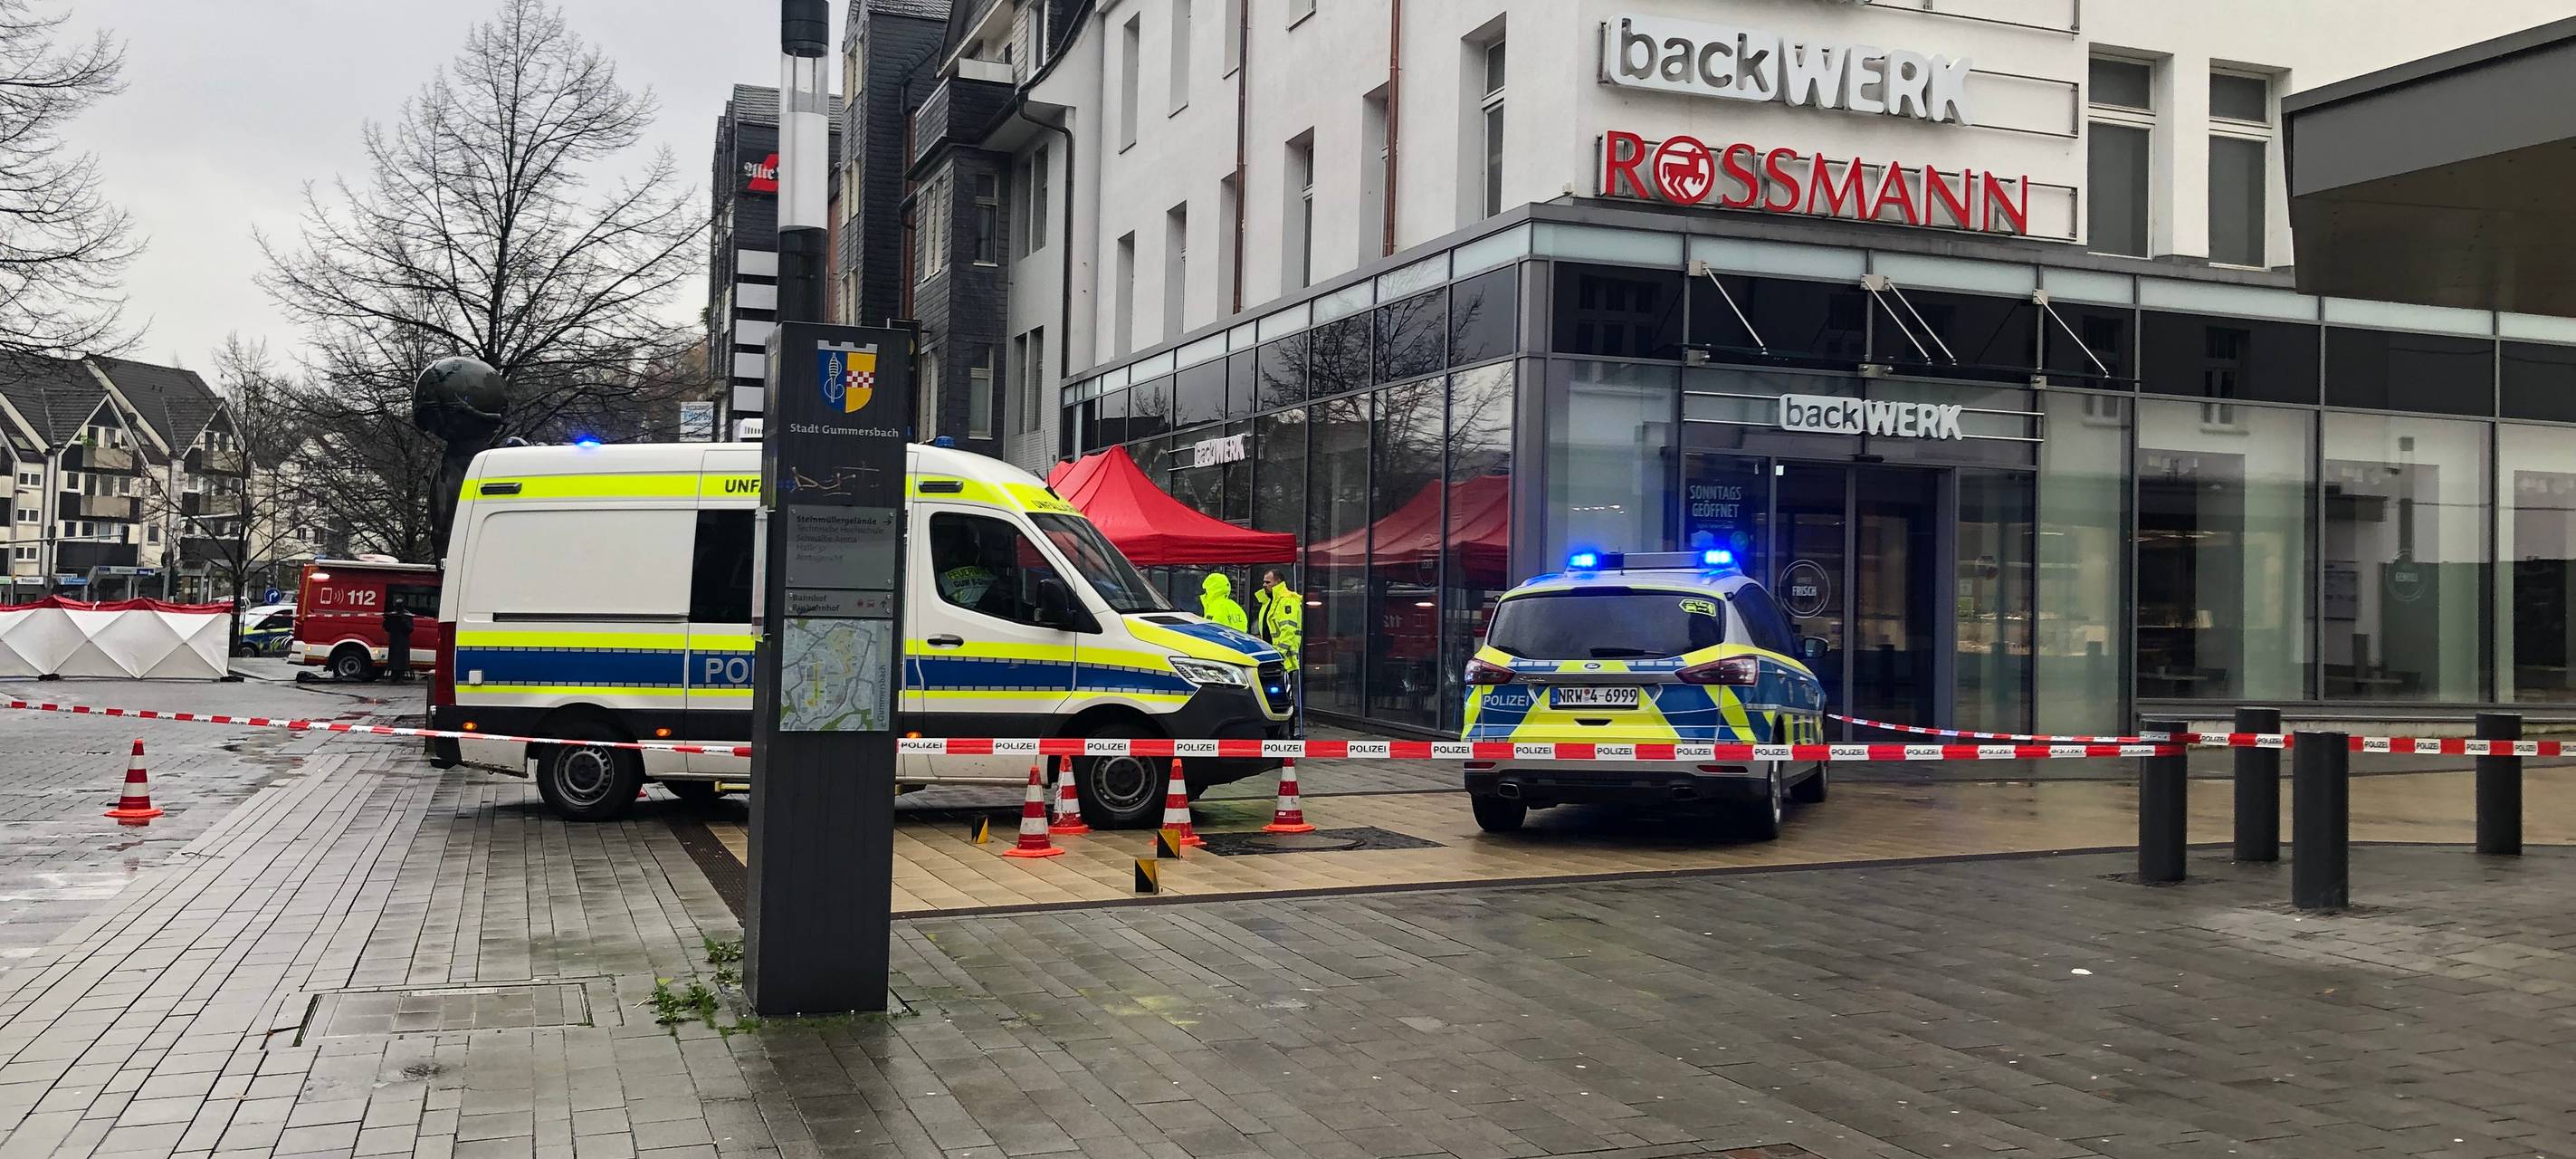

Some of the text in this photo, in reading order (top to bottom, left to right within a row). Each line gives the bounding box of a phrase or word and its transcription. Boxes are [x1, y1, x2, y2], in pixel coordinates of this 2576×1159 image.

[1613, 16, 1973, 125] backWERK
[1602, 130, 2027, 235] ROSSMANN
[1780, 394, 1963, 440] backWERK
[790, 423, 899, 437] Stadt Gummersbach
[1689, 484, 1742, 500] SONNTAGS
[1692, 500, 1740, 518] GEÖFFNET
[348, 589, 377, 606] 112
[1792, 586, 1818, 597] FRISCH
[1484, 694, 1530, 706] POLIZEI
[1558, 688, 1637, 703] NRW 4-6999
[995, 742, 1035, 750] POLIZEI
[1087, 742, 1127, 751] POLIZEI
[1177, 743, 1216, 752] POLIZEI
[1264, 744, 1302, 752] POLIZEI
[1350, 745, 1387, 753] POLIZEI
[1597, 747, 1633, 755] POLIZEI
